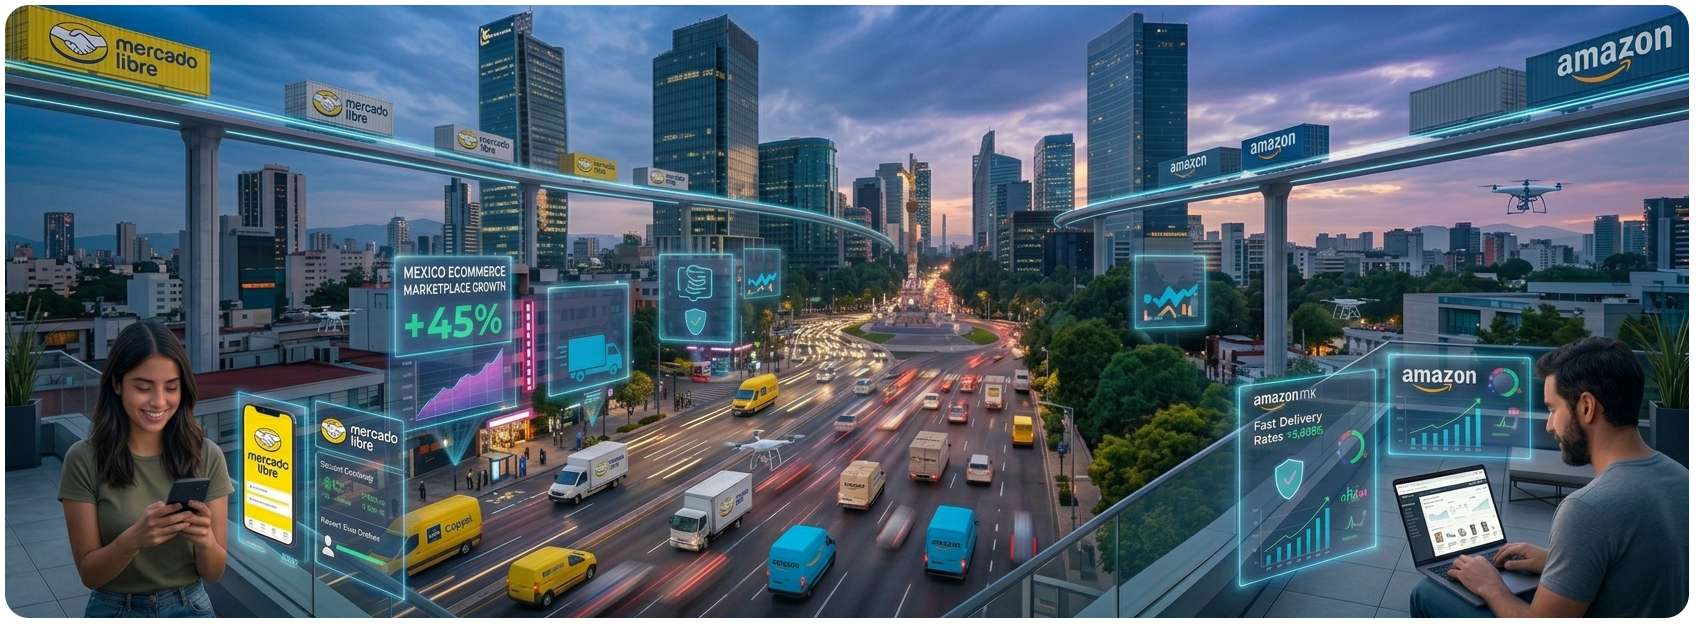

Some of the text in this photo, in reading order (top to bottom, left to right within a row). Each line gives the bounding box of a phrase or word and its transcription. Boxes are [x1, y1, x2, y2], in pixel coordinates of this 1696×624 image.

[116, 38, 198, 69] mercado
[1557, 24, 1672, 77] amazon
[116, 51, 158, 77] libre
[345, 98, 389, 117] mercado
[1250, 132, 1296, 155] amazon
[403, 265, 506, 279] MEXICO ECOMMERCE
[403, 281, 506, 296] MARKETPLACE GROWTH
[404, 303, 503, 340] +45%
[1402, 368, 1477, 384] amazon
[1254, 412, 1323, 431] Fast Delivery
[350, 425, 398, 444] mercado
[350, 435, 374, 452] libre
[1254, 433, 1284, 446] Rates
